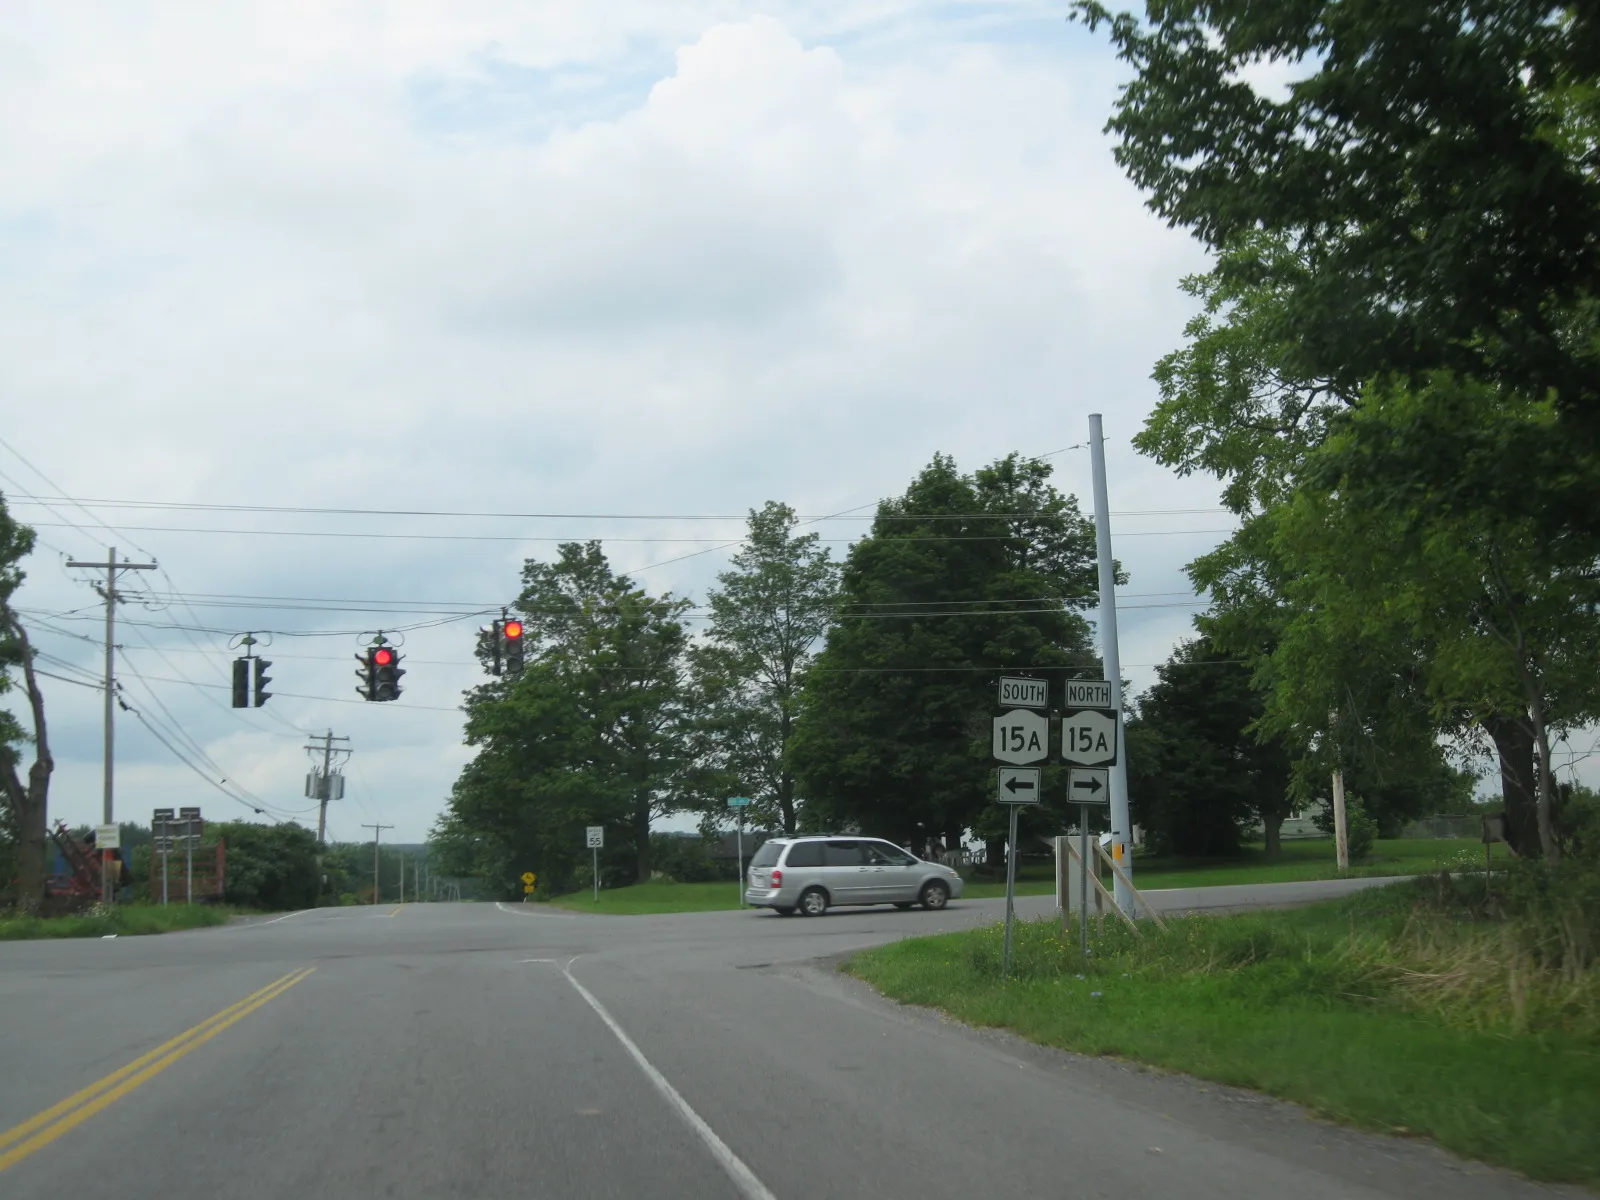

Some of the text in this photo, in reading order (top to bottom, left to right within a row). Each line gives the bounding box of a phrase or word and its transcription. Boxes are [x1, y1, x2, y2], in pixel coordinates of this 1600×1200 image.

[1003, 683, 1045, 702] SOUTH
[1069, 685, 1109, 702] NORTH
[1000, 726, 1041, 752] 15A
[1069, 726, 1108, 752] 15A
[589, 837, 602, 846] 55
